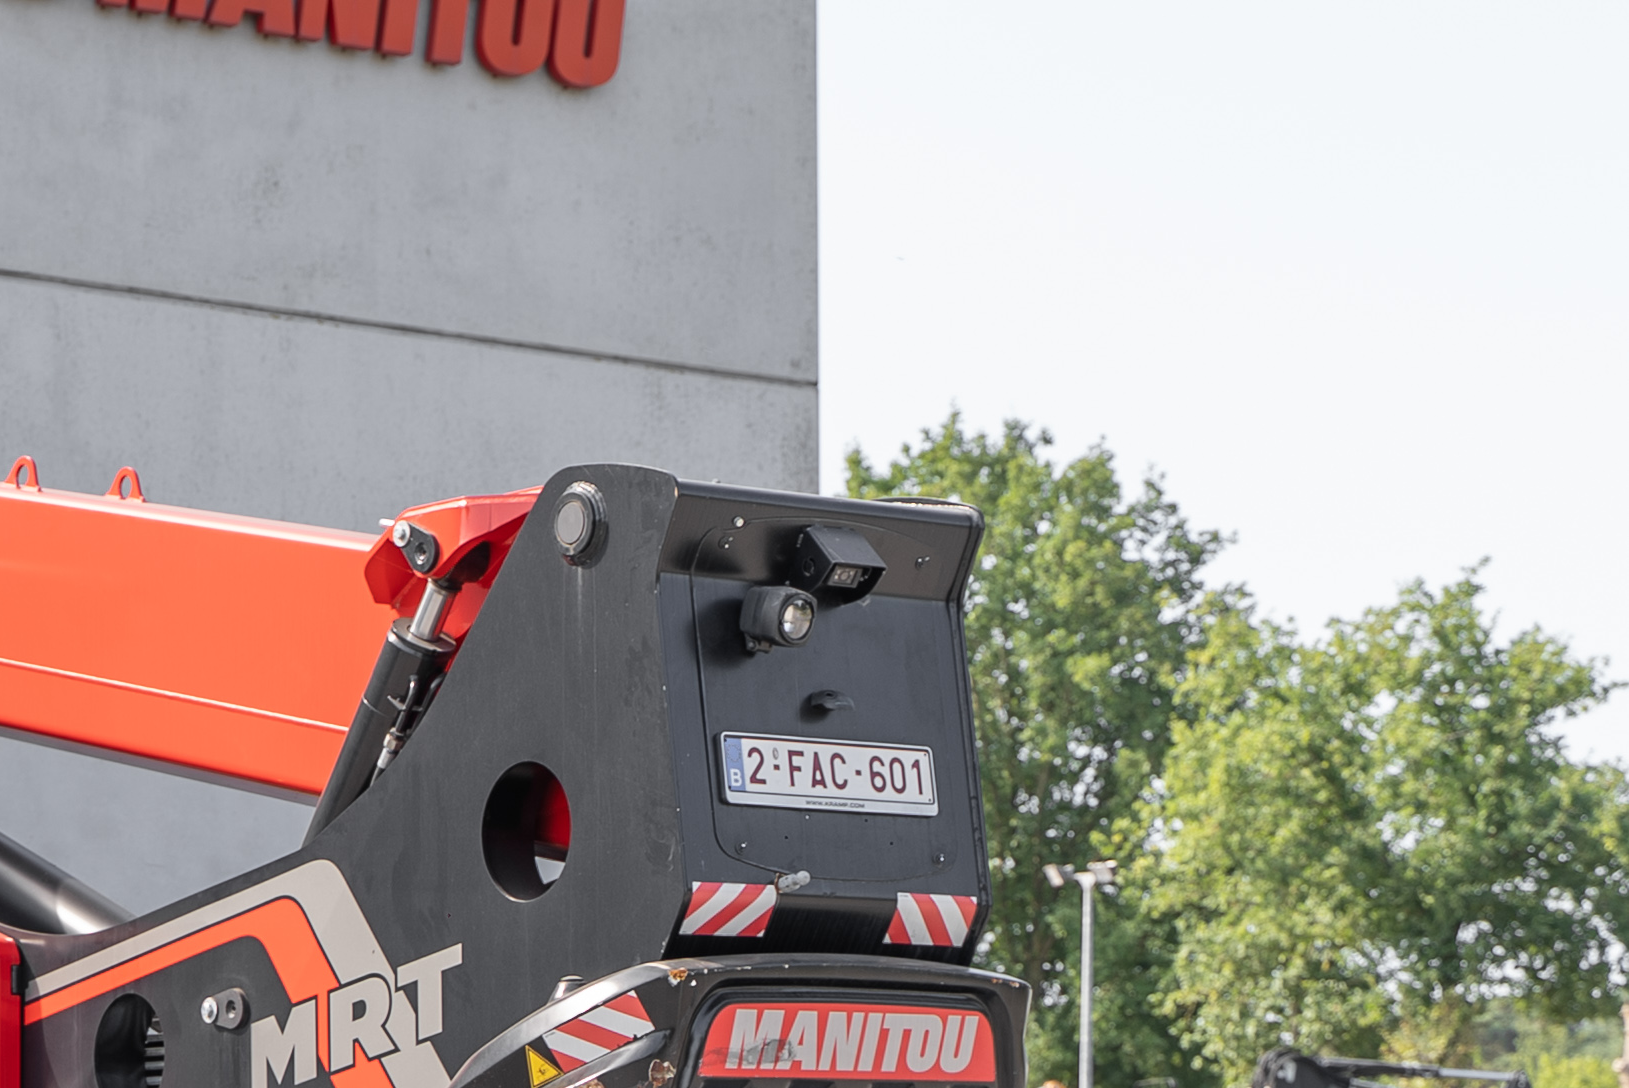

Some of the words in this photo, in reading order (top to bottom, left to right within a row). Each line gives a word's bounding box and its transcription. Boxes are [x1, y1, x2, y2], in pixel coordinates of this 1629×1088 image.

[730, 768, 742, 786] B
[747, 747, 924, 795] 2-FAC-601
[724, 1008, 979, 1073] MANITOU
